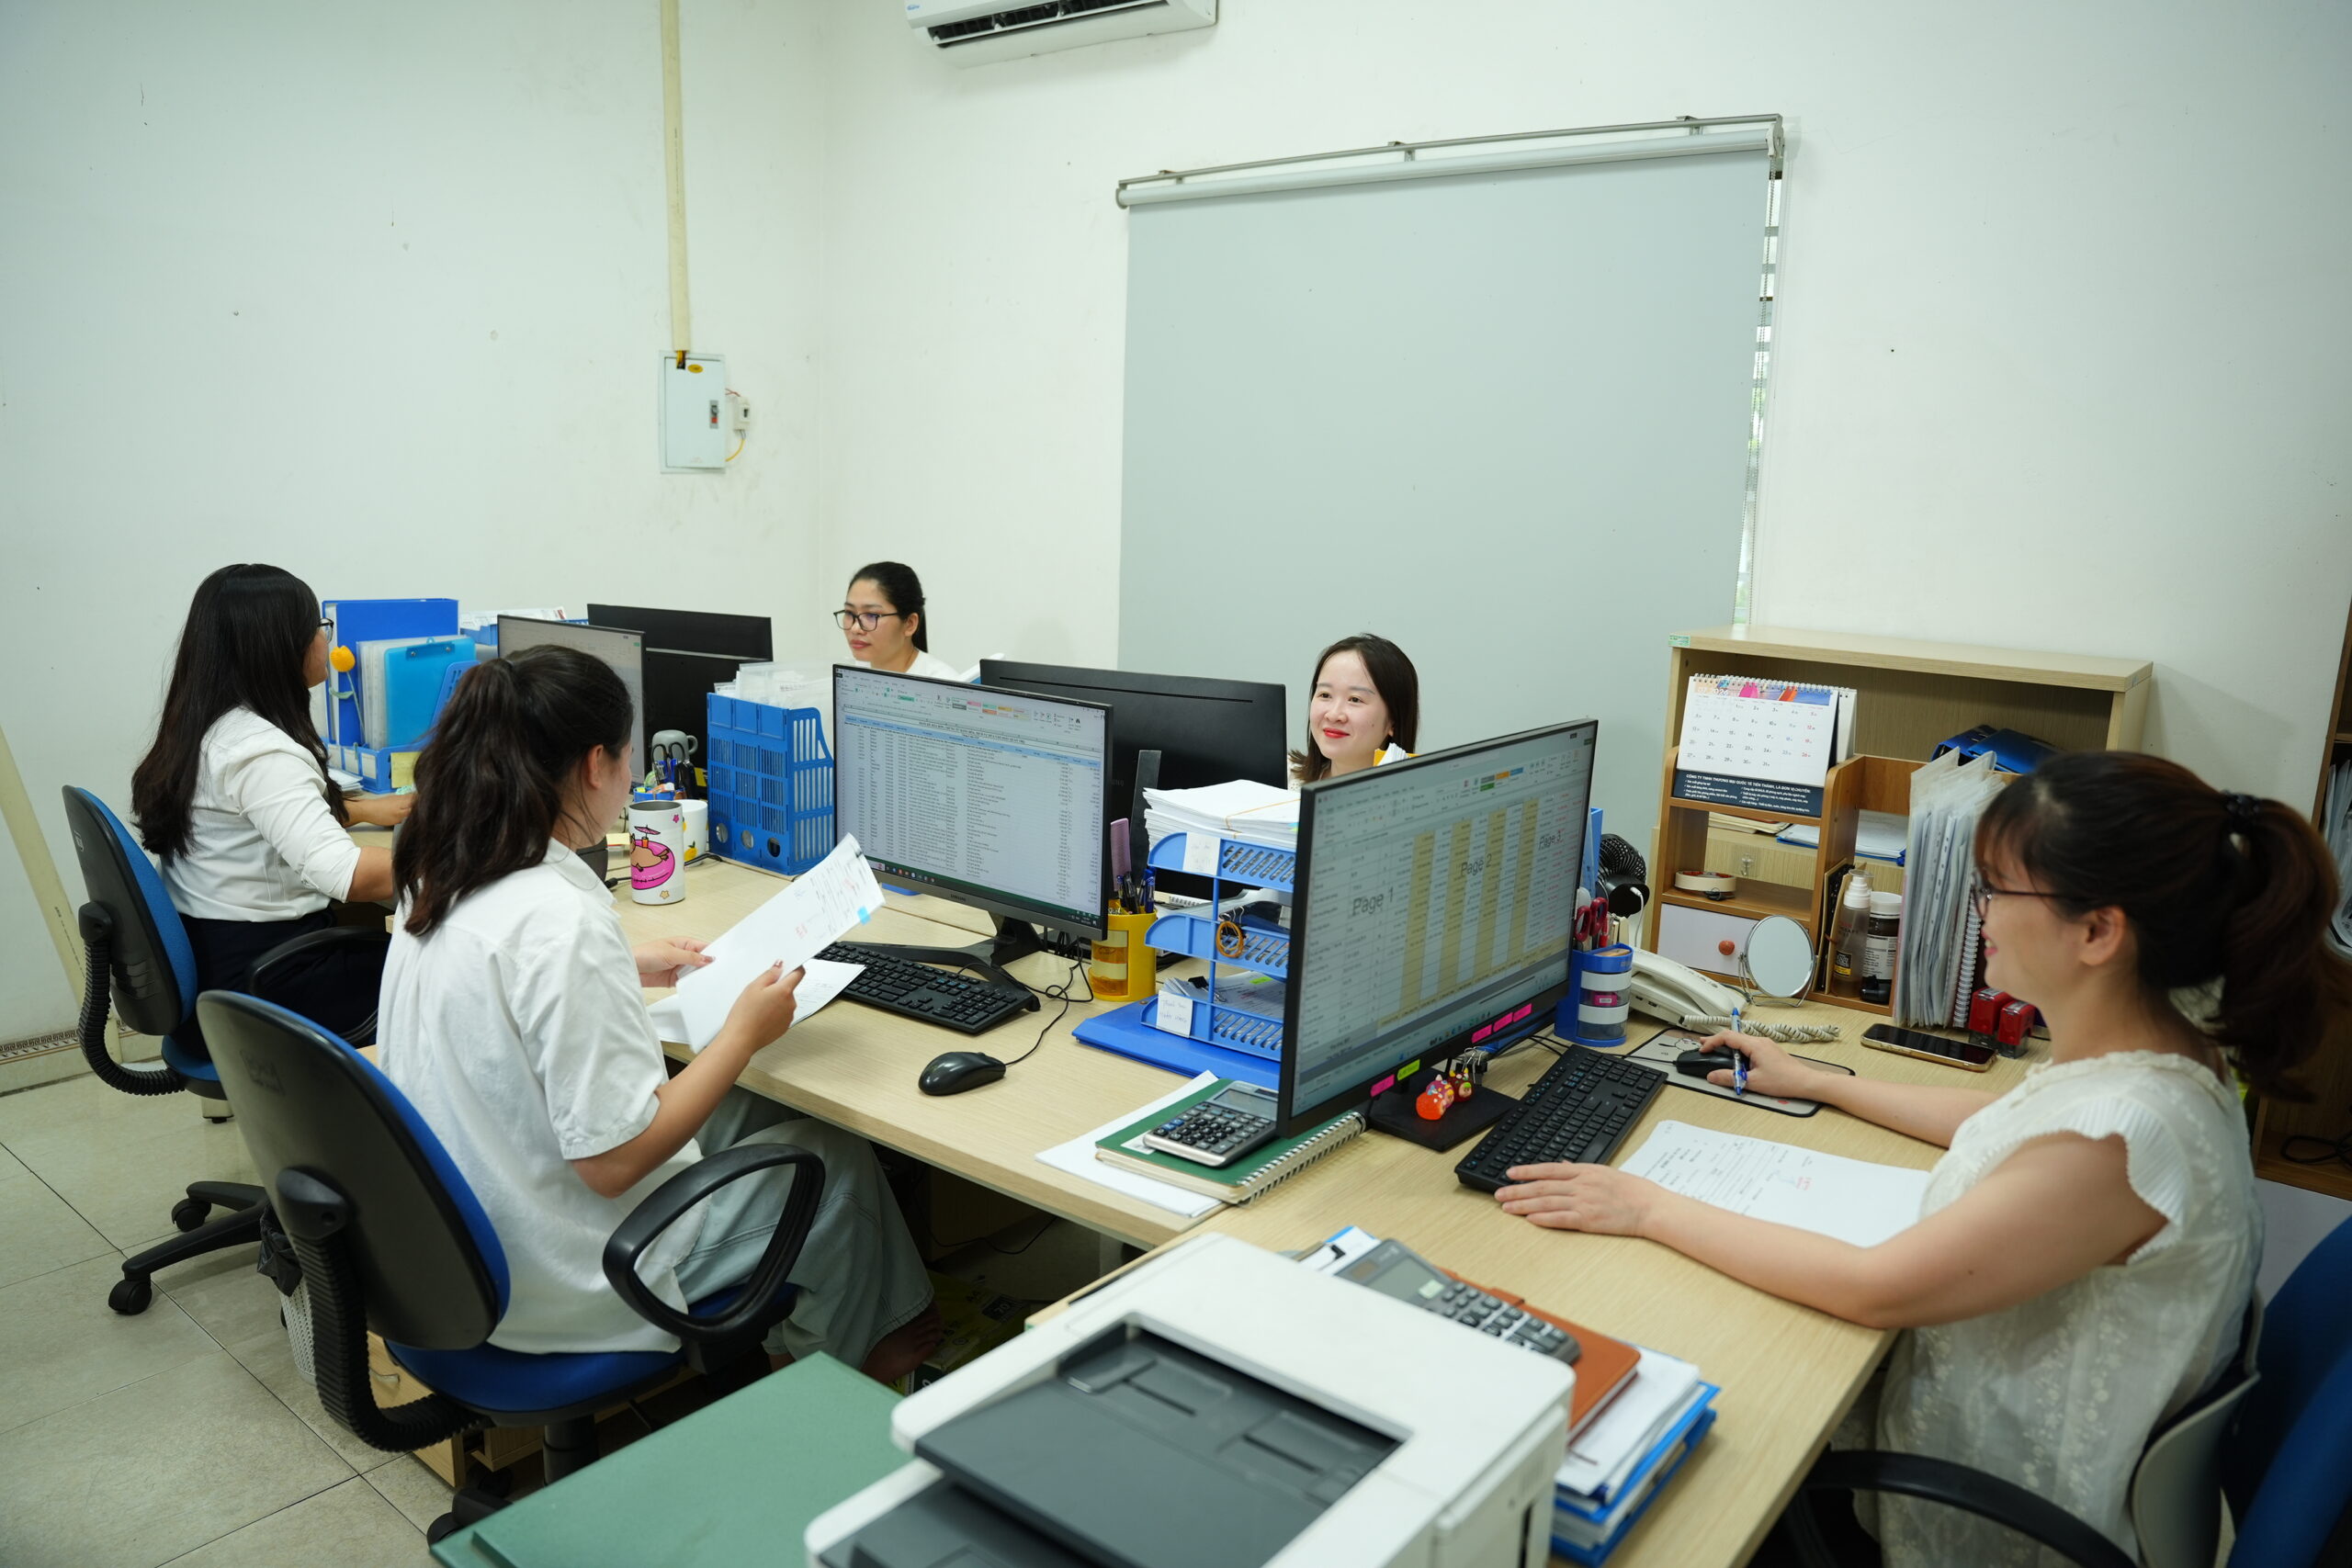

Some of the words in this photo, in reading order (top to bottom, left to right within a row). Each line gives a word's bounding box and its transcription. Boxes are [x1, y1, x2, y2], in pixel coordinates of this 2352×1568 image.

[1539, 834, 1555, 851] Page
[1556, 830, 1562, 842] 3
[1461, 858, 1484, 876] Page
[1486, 853, 1492, 868] 2
[1352, 896, 1384, 917] Page
[1388, 886, 1394, 903] 1
